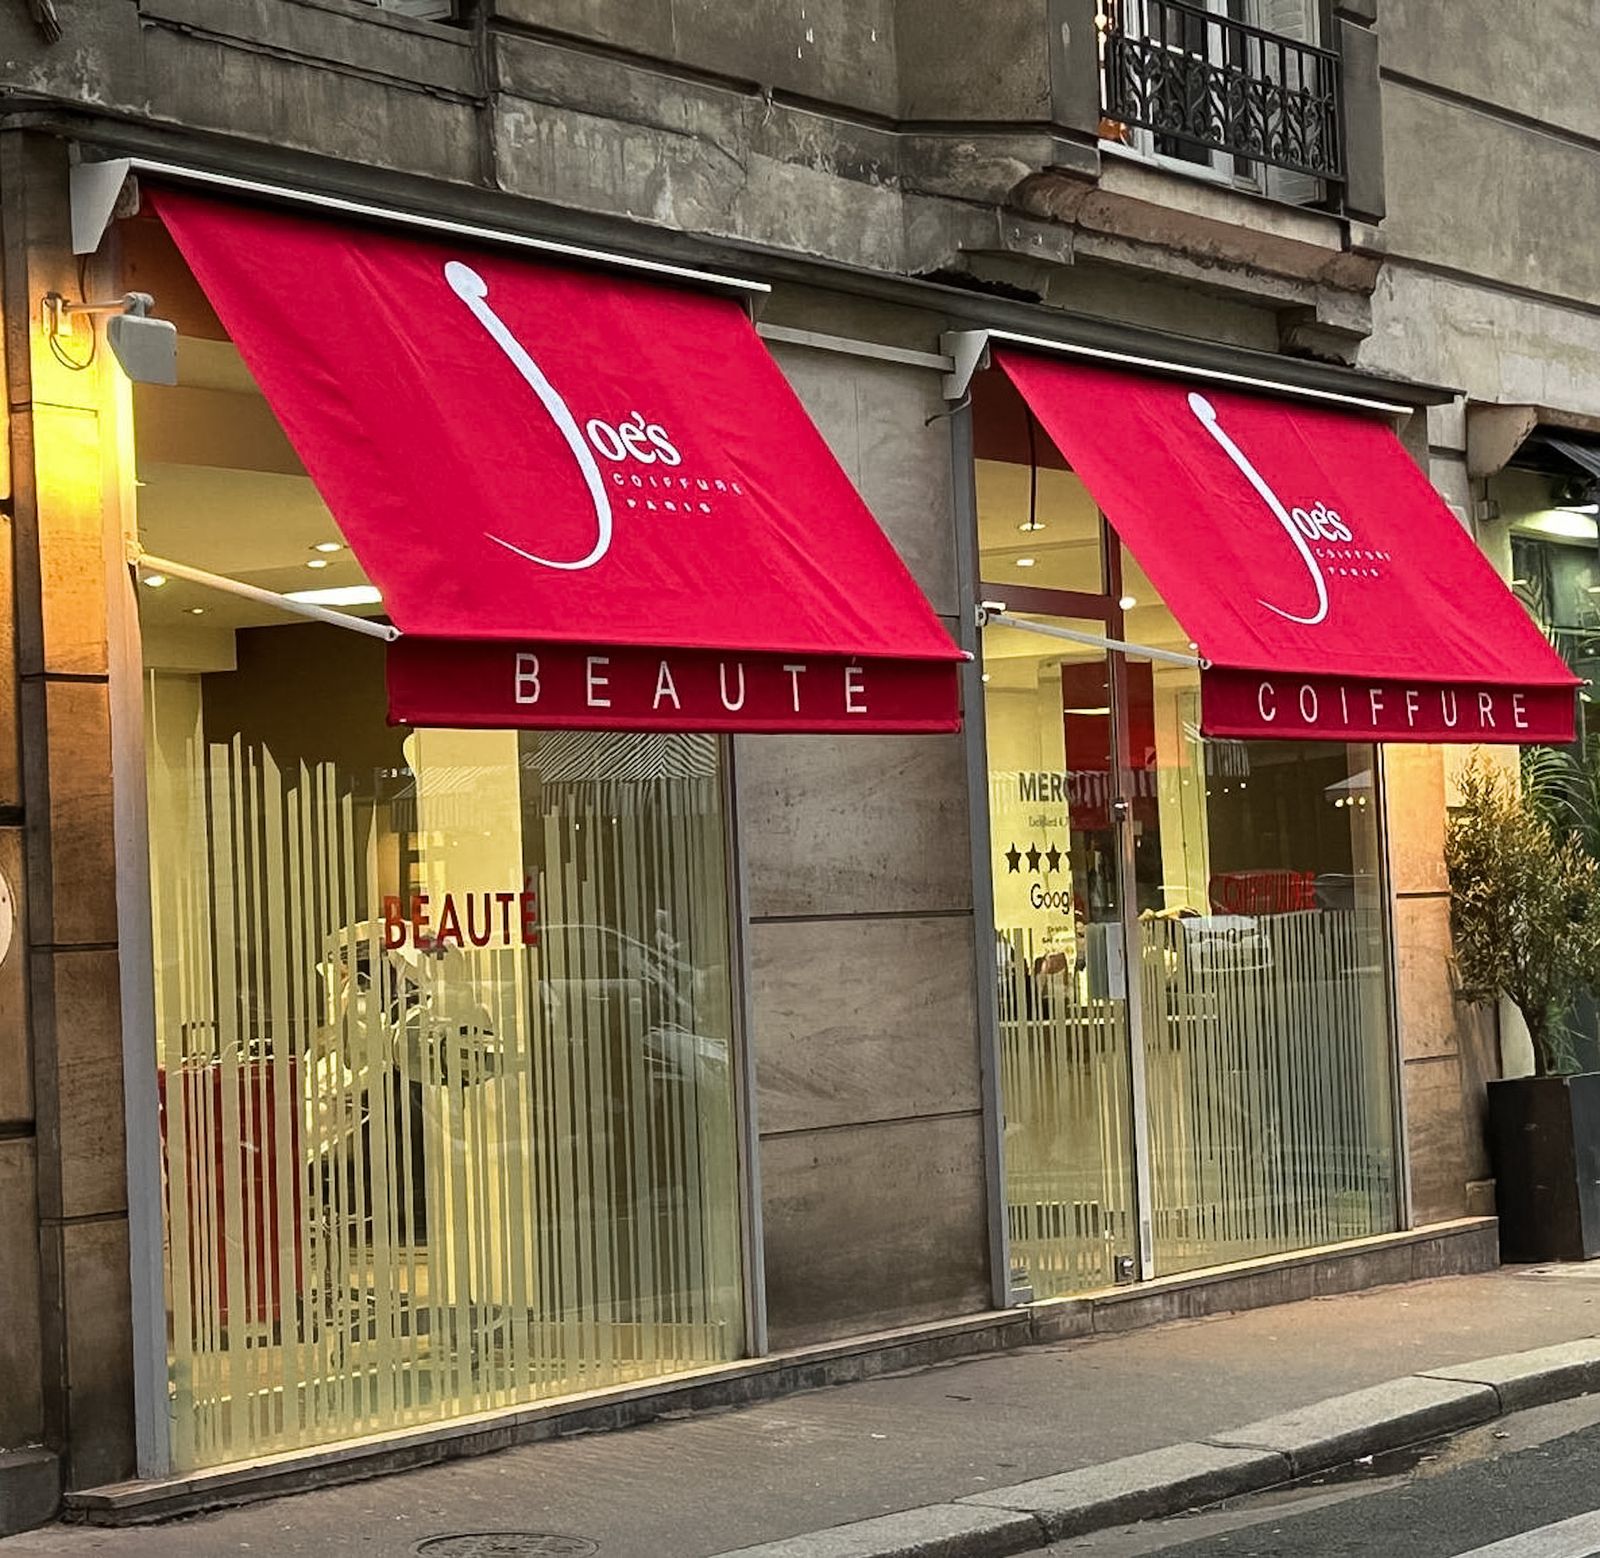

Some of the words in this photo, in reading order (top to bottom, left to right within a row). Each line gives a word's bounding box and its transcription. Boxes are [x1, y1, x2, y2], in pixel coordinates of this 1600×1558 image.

[444, 261, 682, 570] Joe's
[1187, 392, 1353, 625] Joe's
[514, 653, 868, 713] BEAUTÉ
[1257, 682, 1529, 728] COIFFURE
[383, 875, 539, 950] BEAUTÉ
